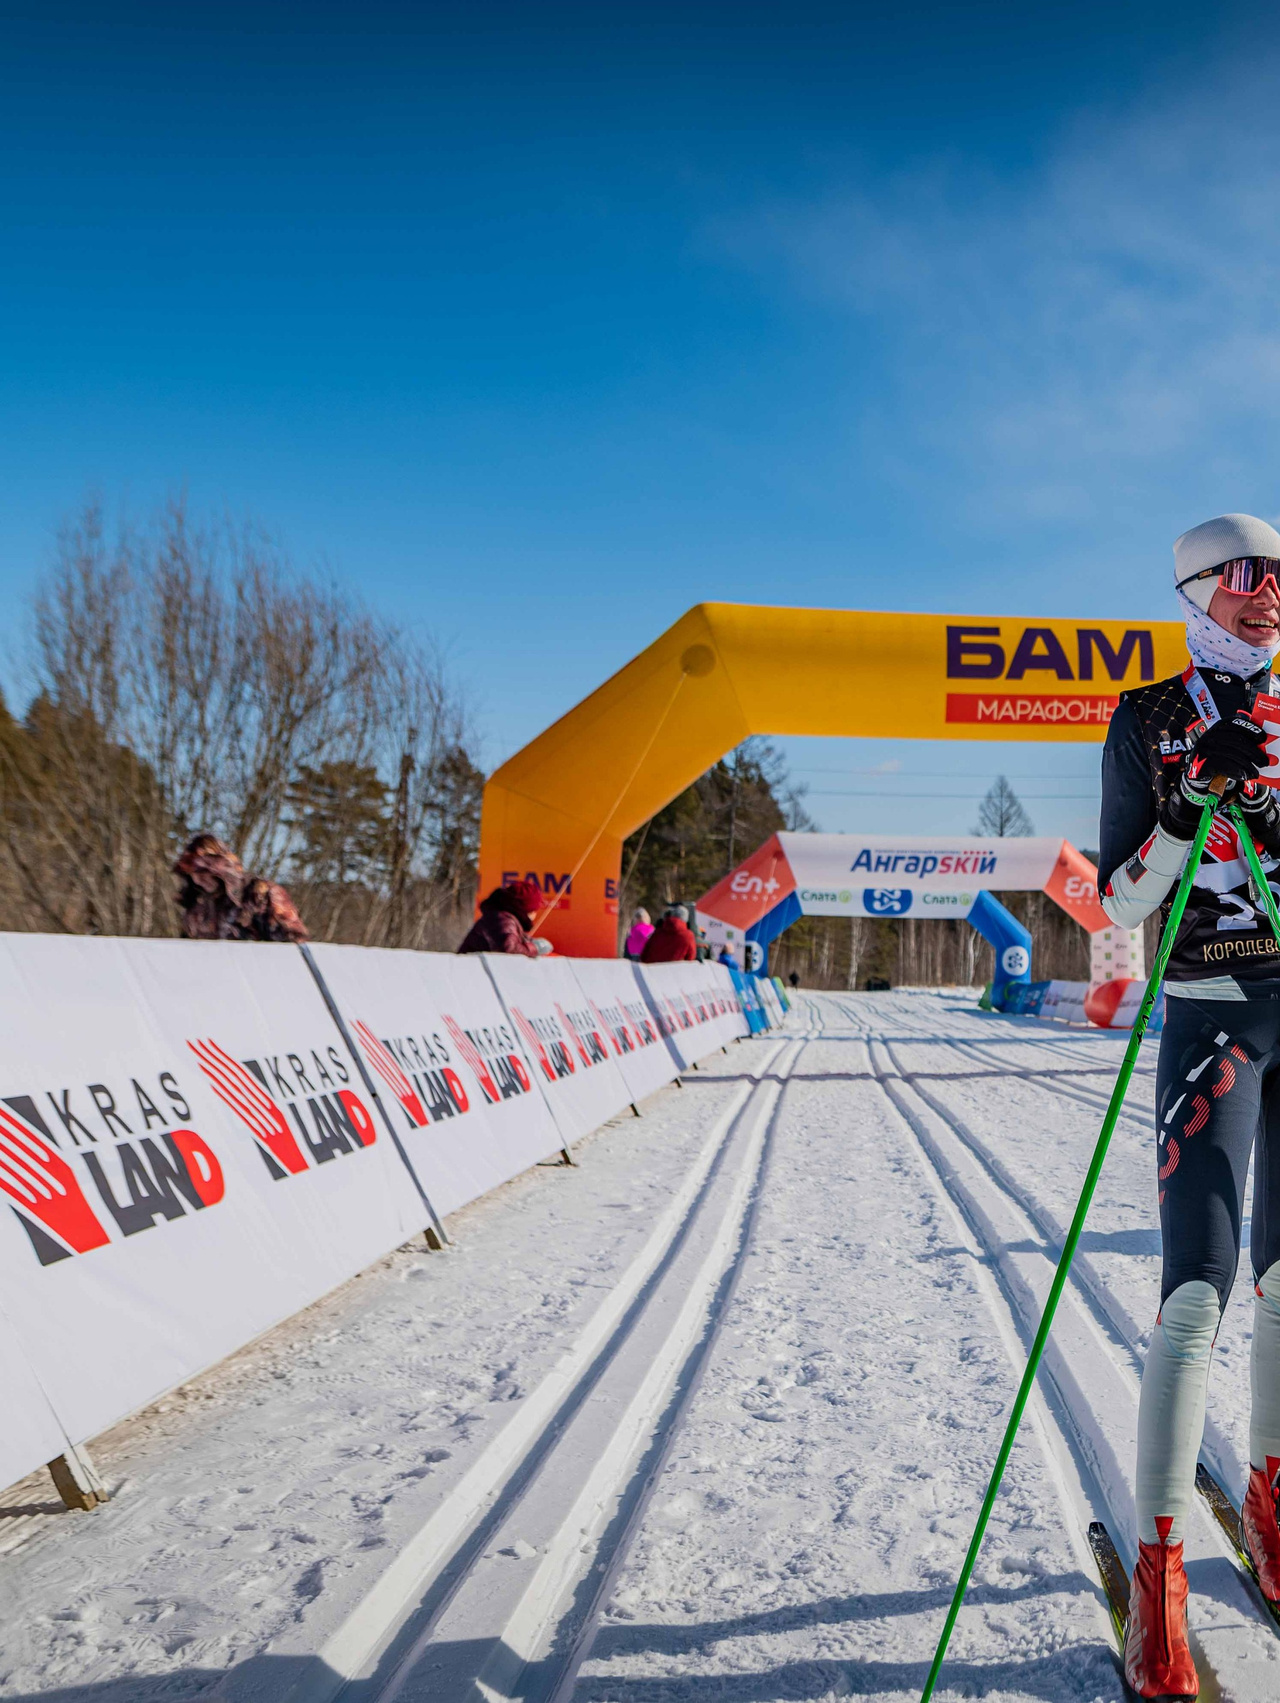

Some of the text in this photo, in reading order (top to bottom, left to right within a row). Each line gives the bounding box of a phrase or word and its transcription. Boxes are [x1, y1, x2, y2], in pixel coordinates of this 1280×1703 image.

[946, 626, 1155, 681] БАМ
[730, 871, 780, 894] En+
[801, 891, 837, 902] Слата
[923, 893, 958, 905] Слата
[393, 1032, 450, 1071] KRAS
[474, 1026, 515, 1056] KRAS
[265, 1045, 350, 1098] KRAS
[412, 1067, 470, 1122] LAND
[487, 1054, 531, 1100] LAND
[46, 1072, 192, 1146] KRAS
[288, 1090, 377, 1165] LAND
[80, 1129, 226, 1238] LAND
